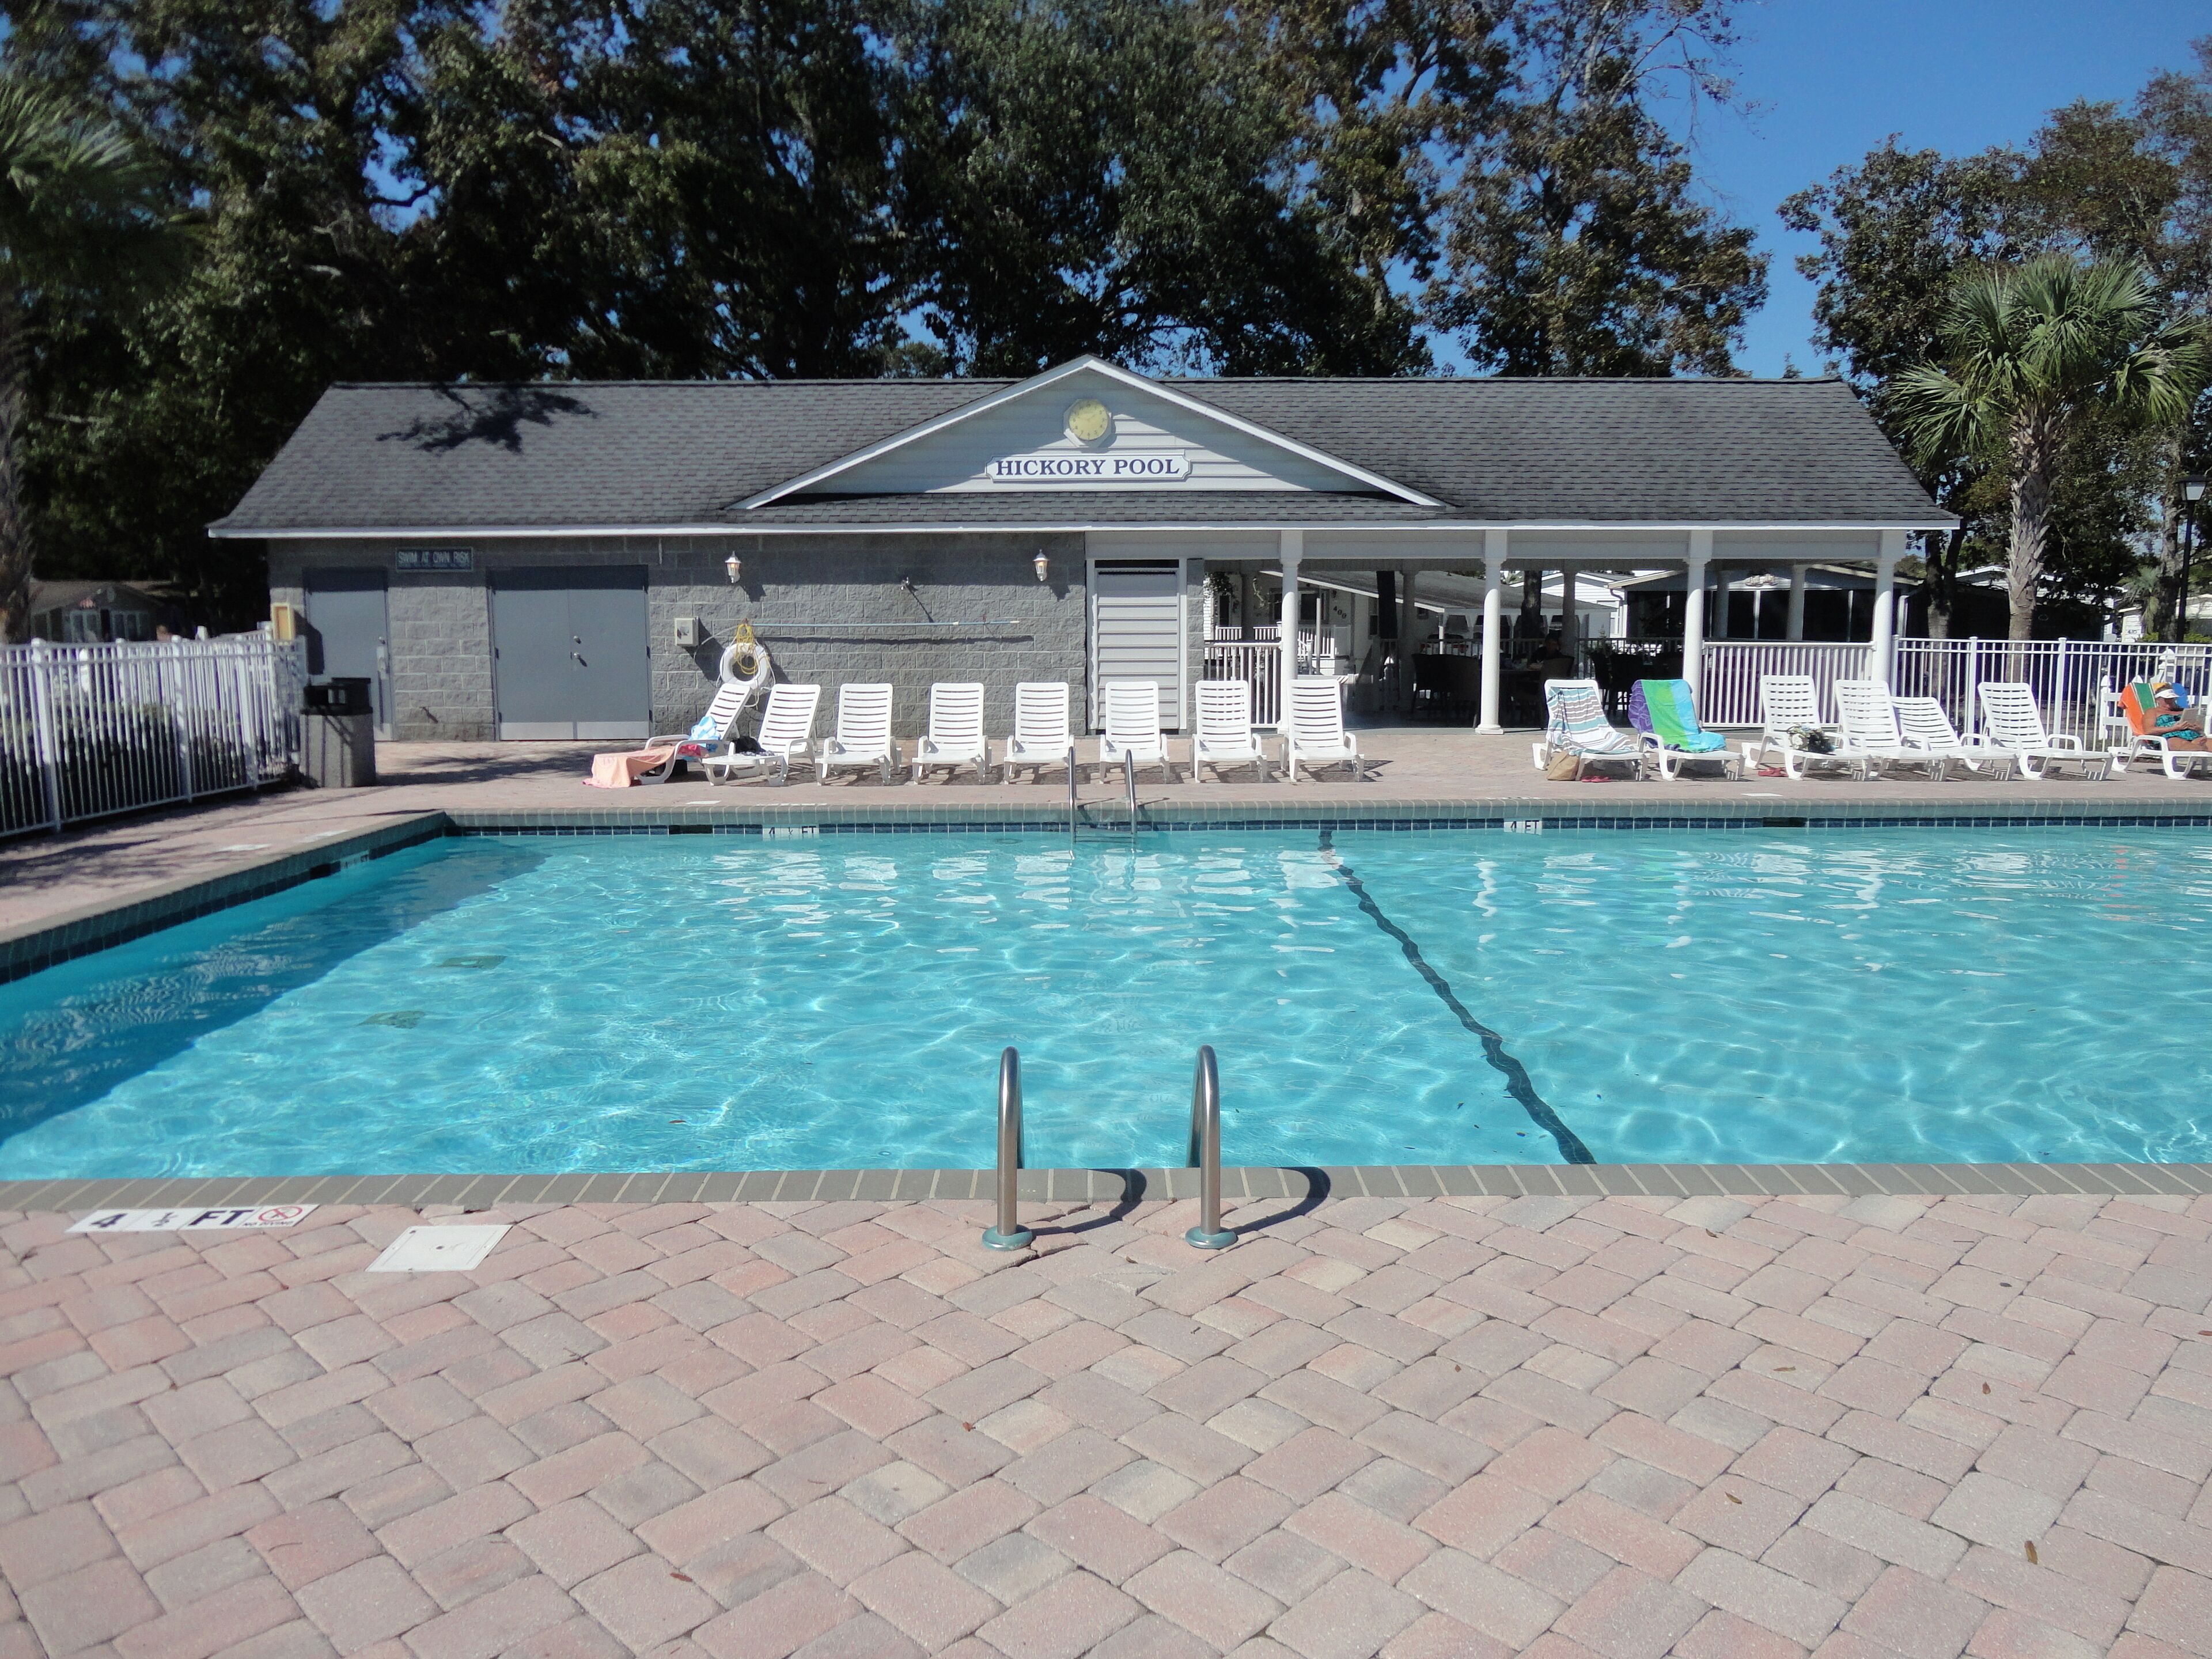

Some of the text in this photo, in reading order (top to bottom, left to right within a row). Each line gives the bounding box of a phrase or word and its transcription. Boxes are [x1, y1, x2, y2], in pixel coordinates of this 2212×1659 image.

[996, 459, 1180, 476] HICKORY POOL
[398, 551, 418, 563] SWIM
[421, 551, 429, 563] AT
[433, 551, 450, 563] OWN
[90, 1213, 128, 1228] 4
[187, 1210, 255, 1225] FT
